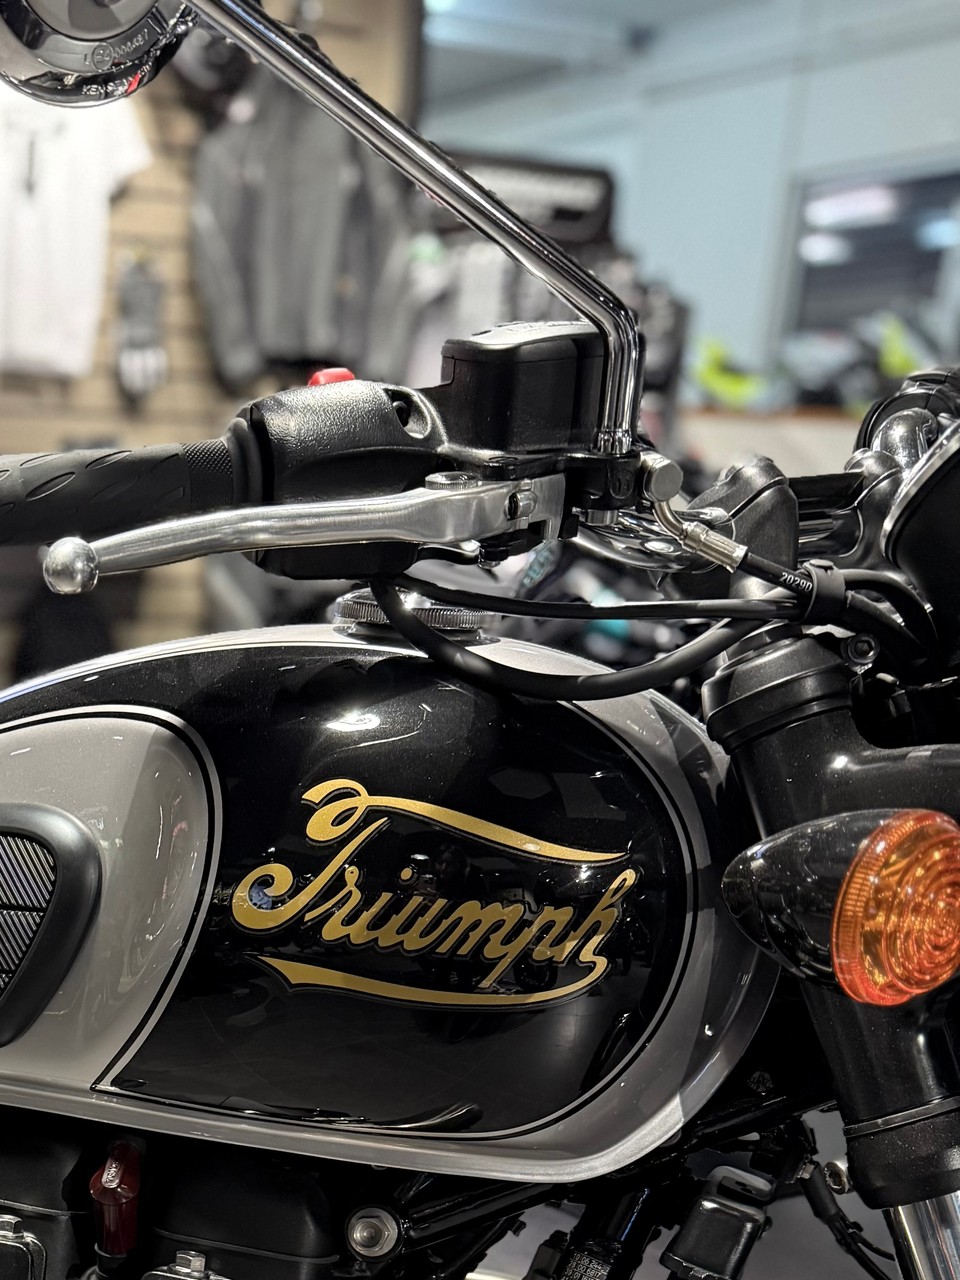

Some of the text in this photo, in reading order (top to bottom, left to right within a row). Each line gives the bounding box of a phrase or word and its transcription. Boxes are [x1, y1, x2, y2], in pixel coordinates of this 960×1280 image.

[231, 778, 638, 1005] Triumph
[577, 1264, 586, 1272] 00
[573, 1271, 581, 1279] 01
